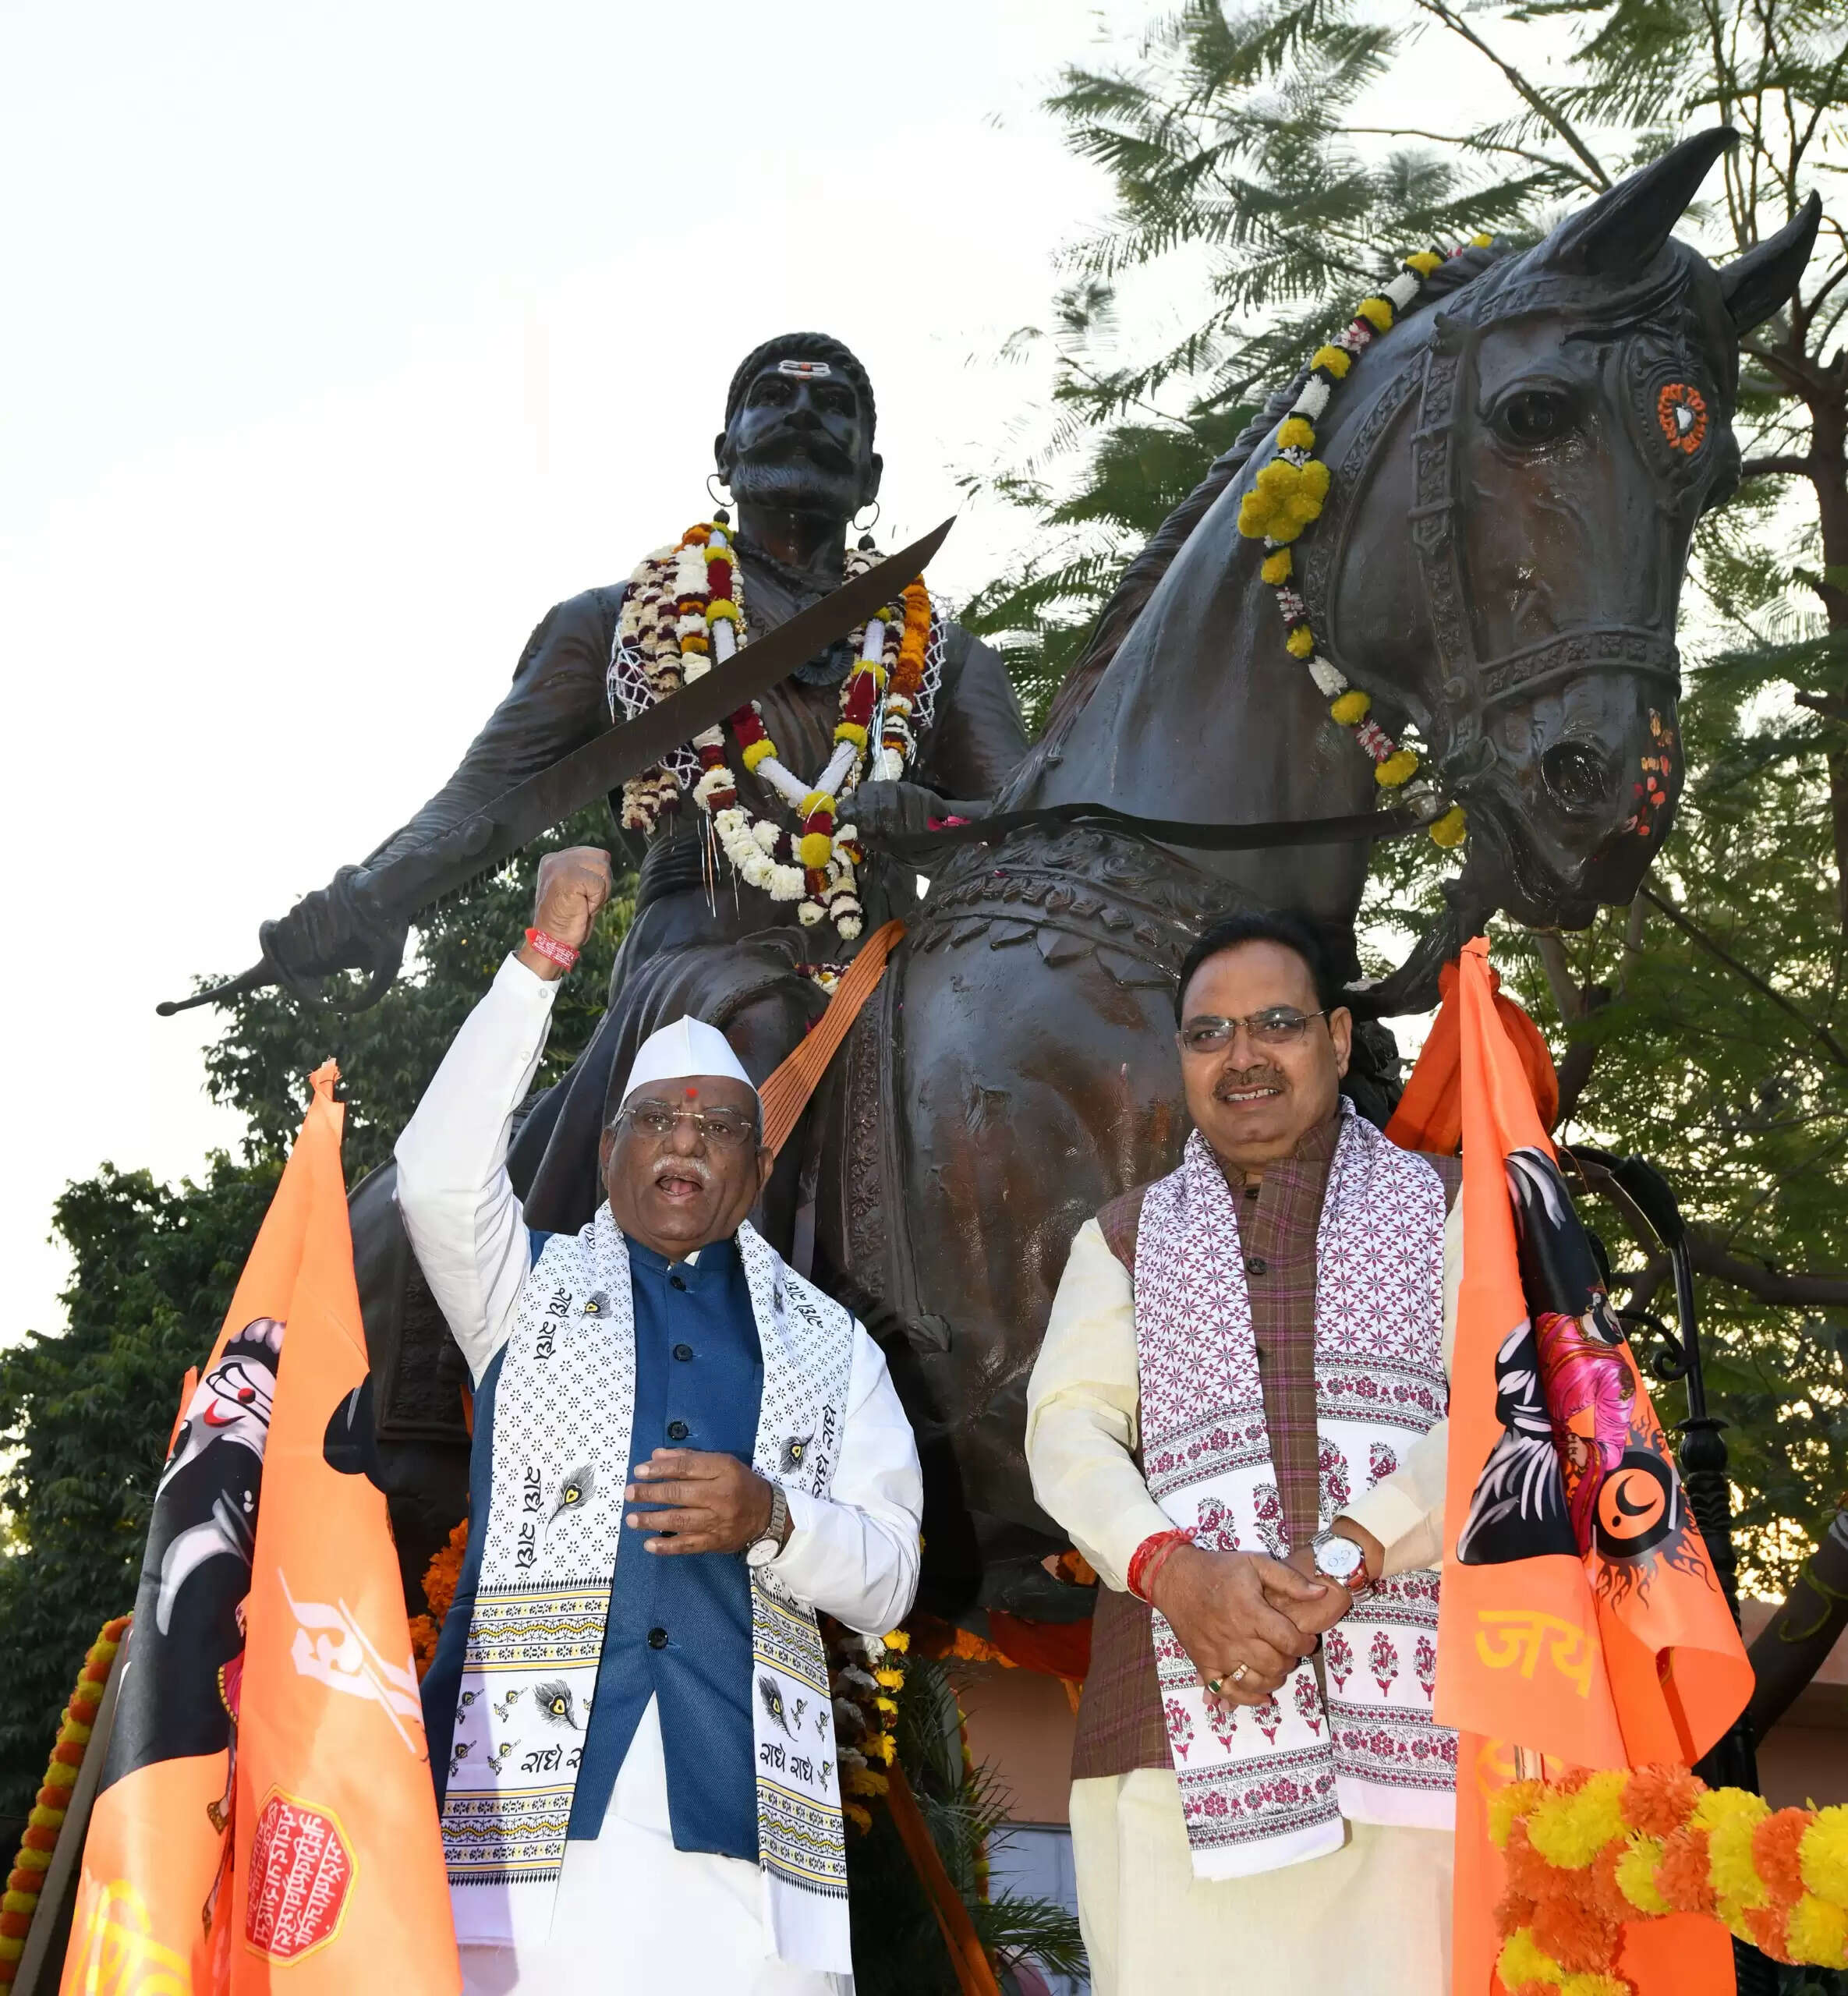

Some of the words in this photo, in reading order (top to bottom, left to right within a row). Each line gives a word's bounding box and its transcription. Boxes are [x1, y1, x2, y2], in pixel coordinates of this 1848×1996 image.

[545, 1287, 572, 1318] राधे
[793, 1304, 823, 1329] राधे
[533, 1321, 557, 1360] राधे
[812, 1453, 830, 1499] राधे
[822, 1403, 837, 1450] राधे
[522, 1466, 544, 1513] राधे
[515, 1522, 537, 1569] राधे
[1475, 1609, 1597, 1698] जय
[521, 1743, 563, 1773] राधे
[759, 1743, 786, 1772] राधे
[790, 1756, 813, 1785] राधे
